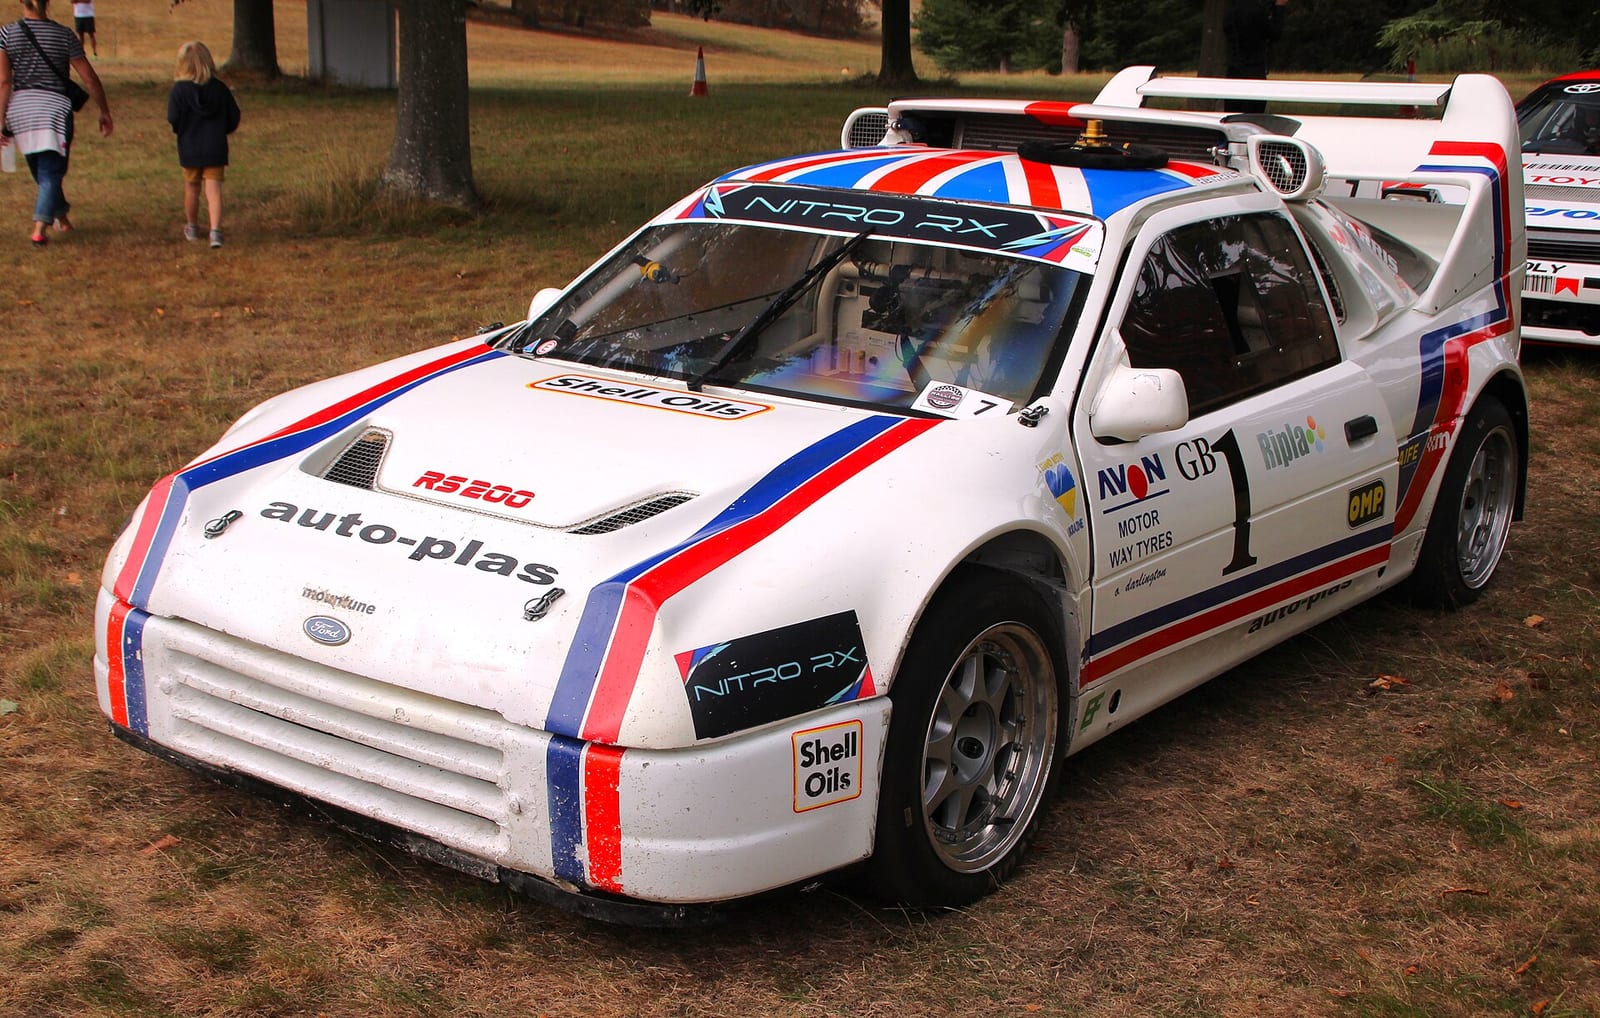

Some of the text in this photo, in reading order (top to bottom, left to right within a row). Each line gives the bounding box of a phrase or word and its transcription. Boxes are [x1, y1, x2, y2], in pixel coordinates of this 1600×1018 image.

[1531, 175, 1600, 185] TOY
[744, 195, 1009, 239] NITRO RX
[545, 376, 748, 417] Shell Oils
[973, 399, 998, 416] 7
[1175, 437, 1216, 481] GB
[1256, 423, 1310, 471] Ripla
[1097, 453, 1166, 500] AVON
[1210, 428, 1257, 576] 1
[1350, 485, 1384, 522] OMP
[259, 500, 560, 587] auto-plas
[1118, 510, 1160, 538] MOTOR
[1110, 531, 1173, 568] WAY TYRES
[310, 620, 341, 638] Ford
[693, 646, 858, 701] NITRO RX
[800, 730, 857, 768] Shell
[804, 768, 851, 798] Oils
